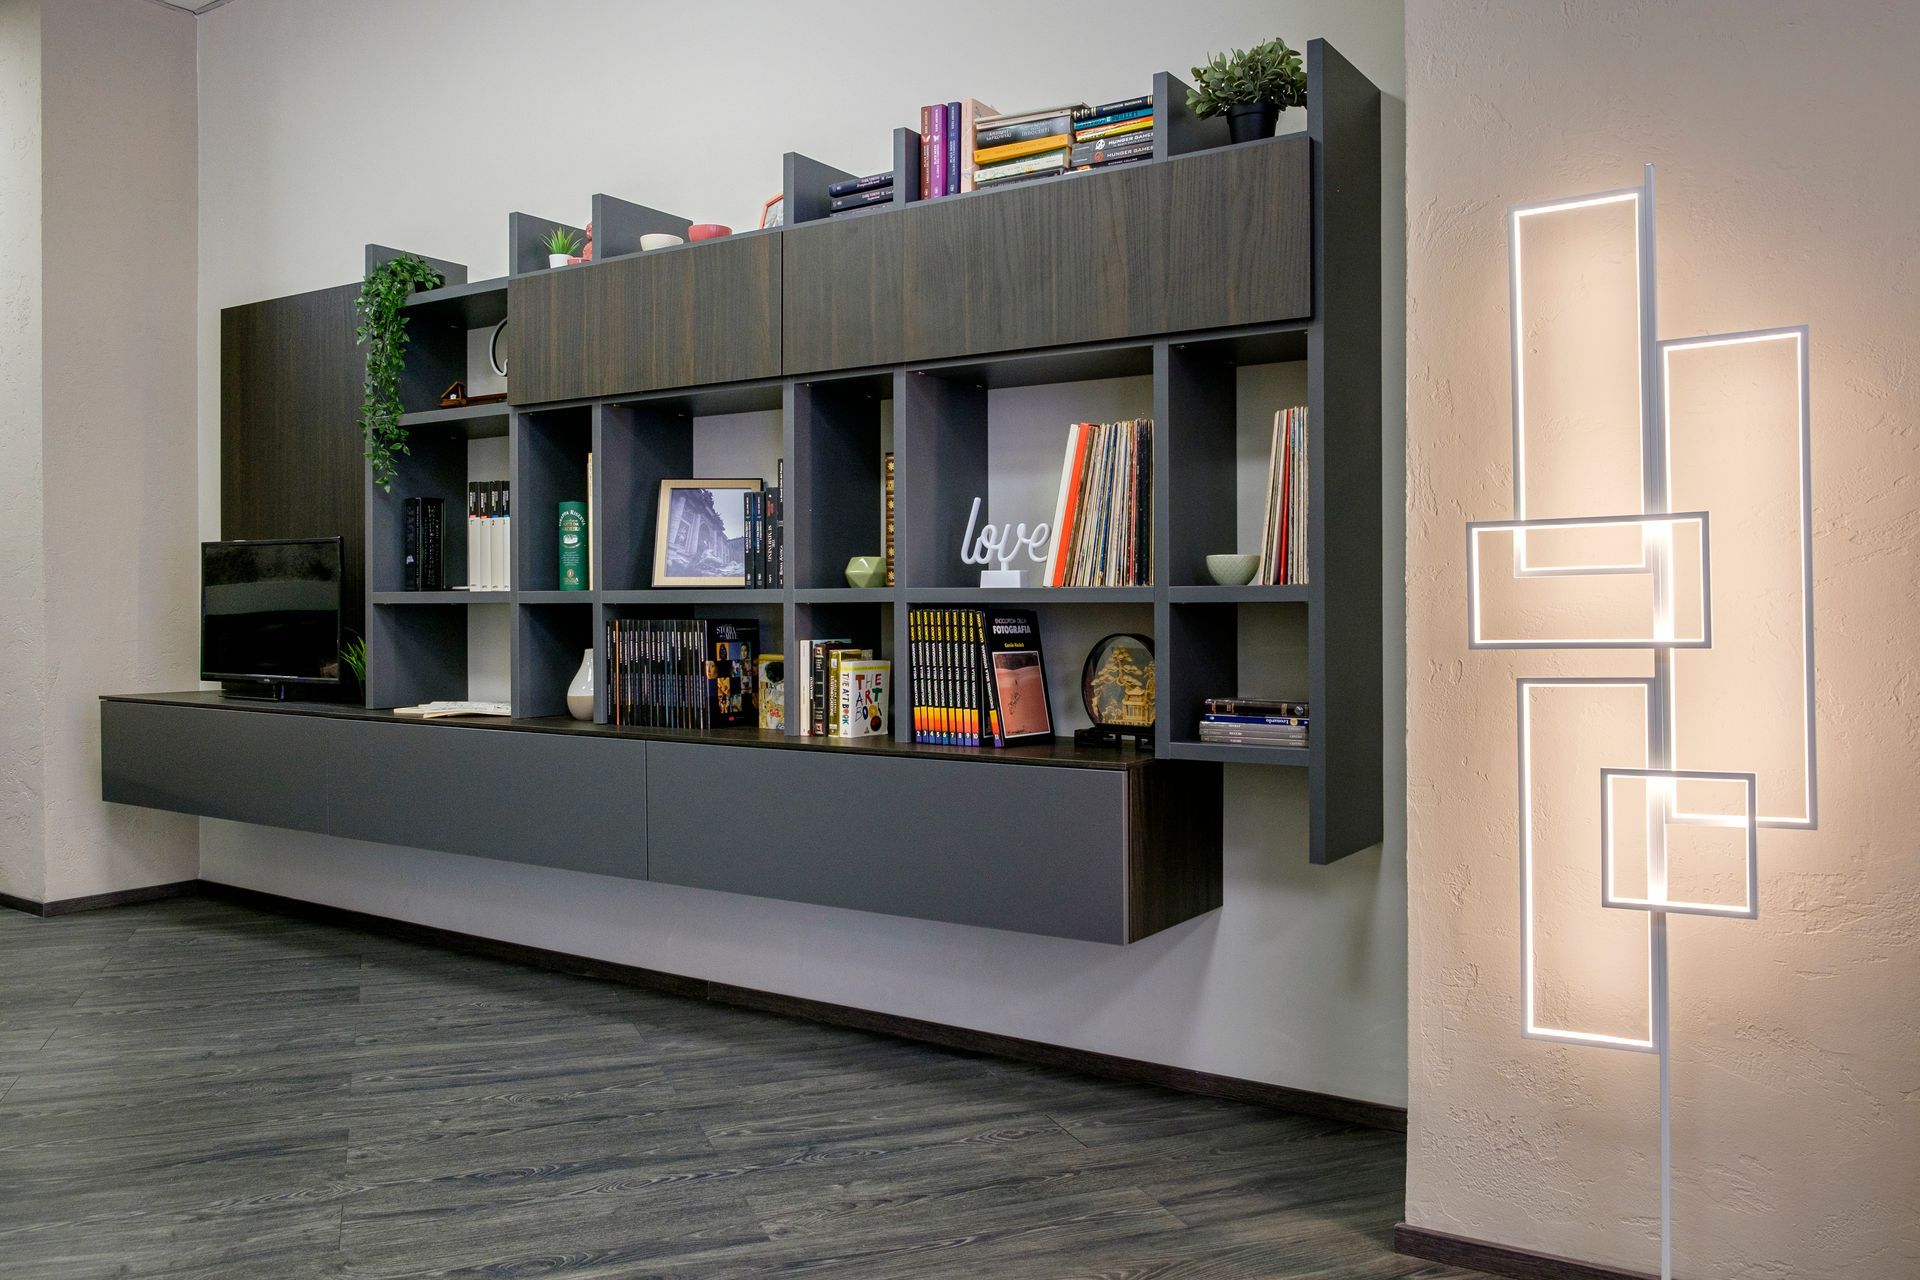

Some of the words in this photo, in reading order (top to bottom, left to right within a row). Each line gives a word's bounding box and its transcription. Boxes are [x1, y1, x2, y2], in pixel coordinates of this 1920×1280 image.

[1108, 136, 1133, 145] HUNGER
[960, 497, 1052, 565] love
[993, 625, 1031, 634] FOTOGRAFIA
[856, 673, 882, 690] THE
[856, 688, 882, 707] ART
